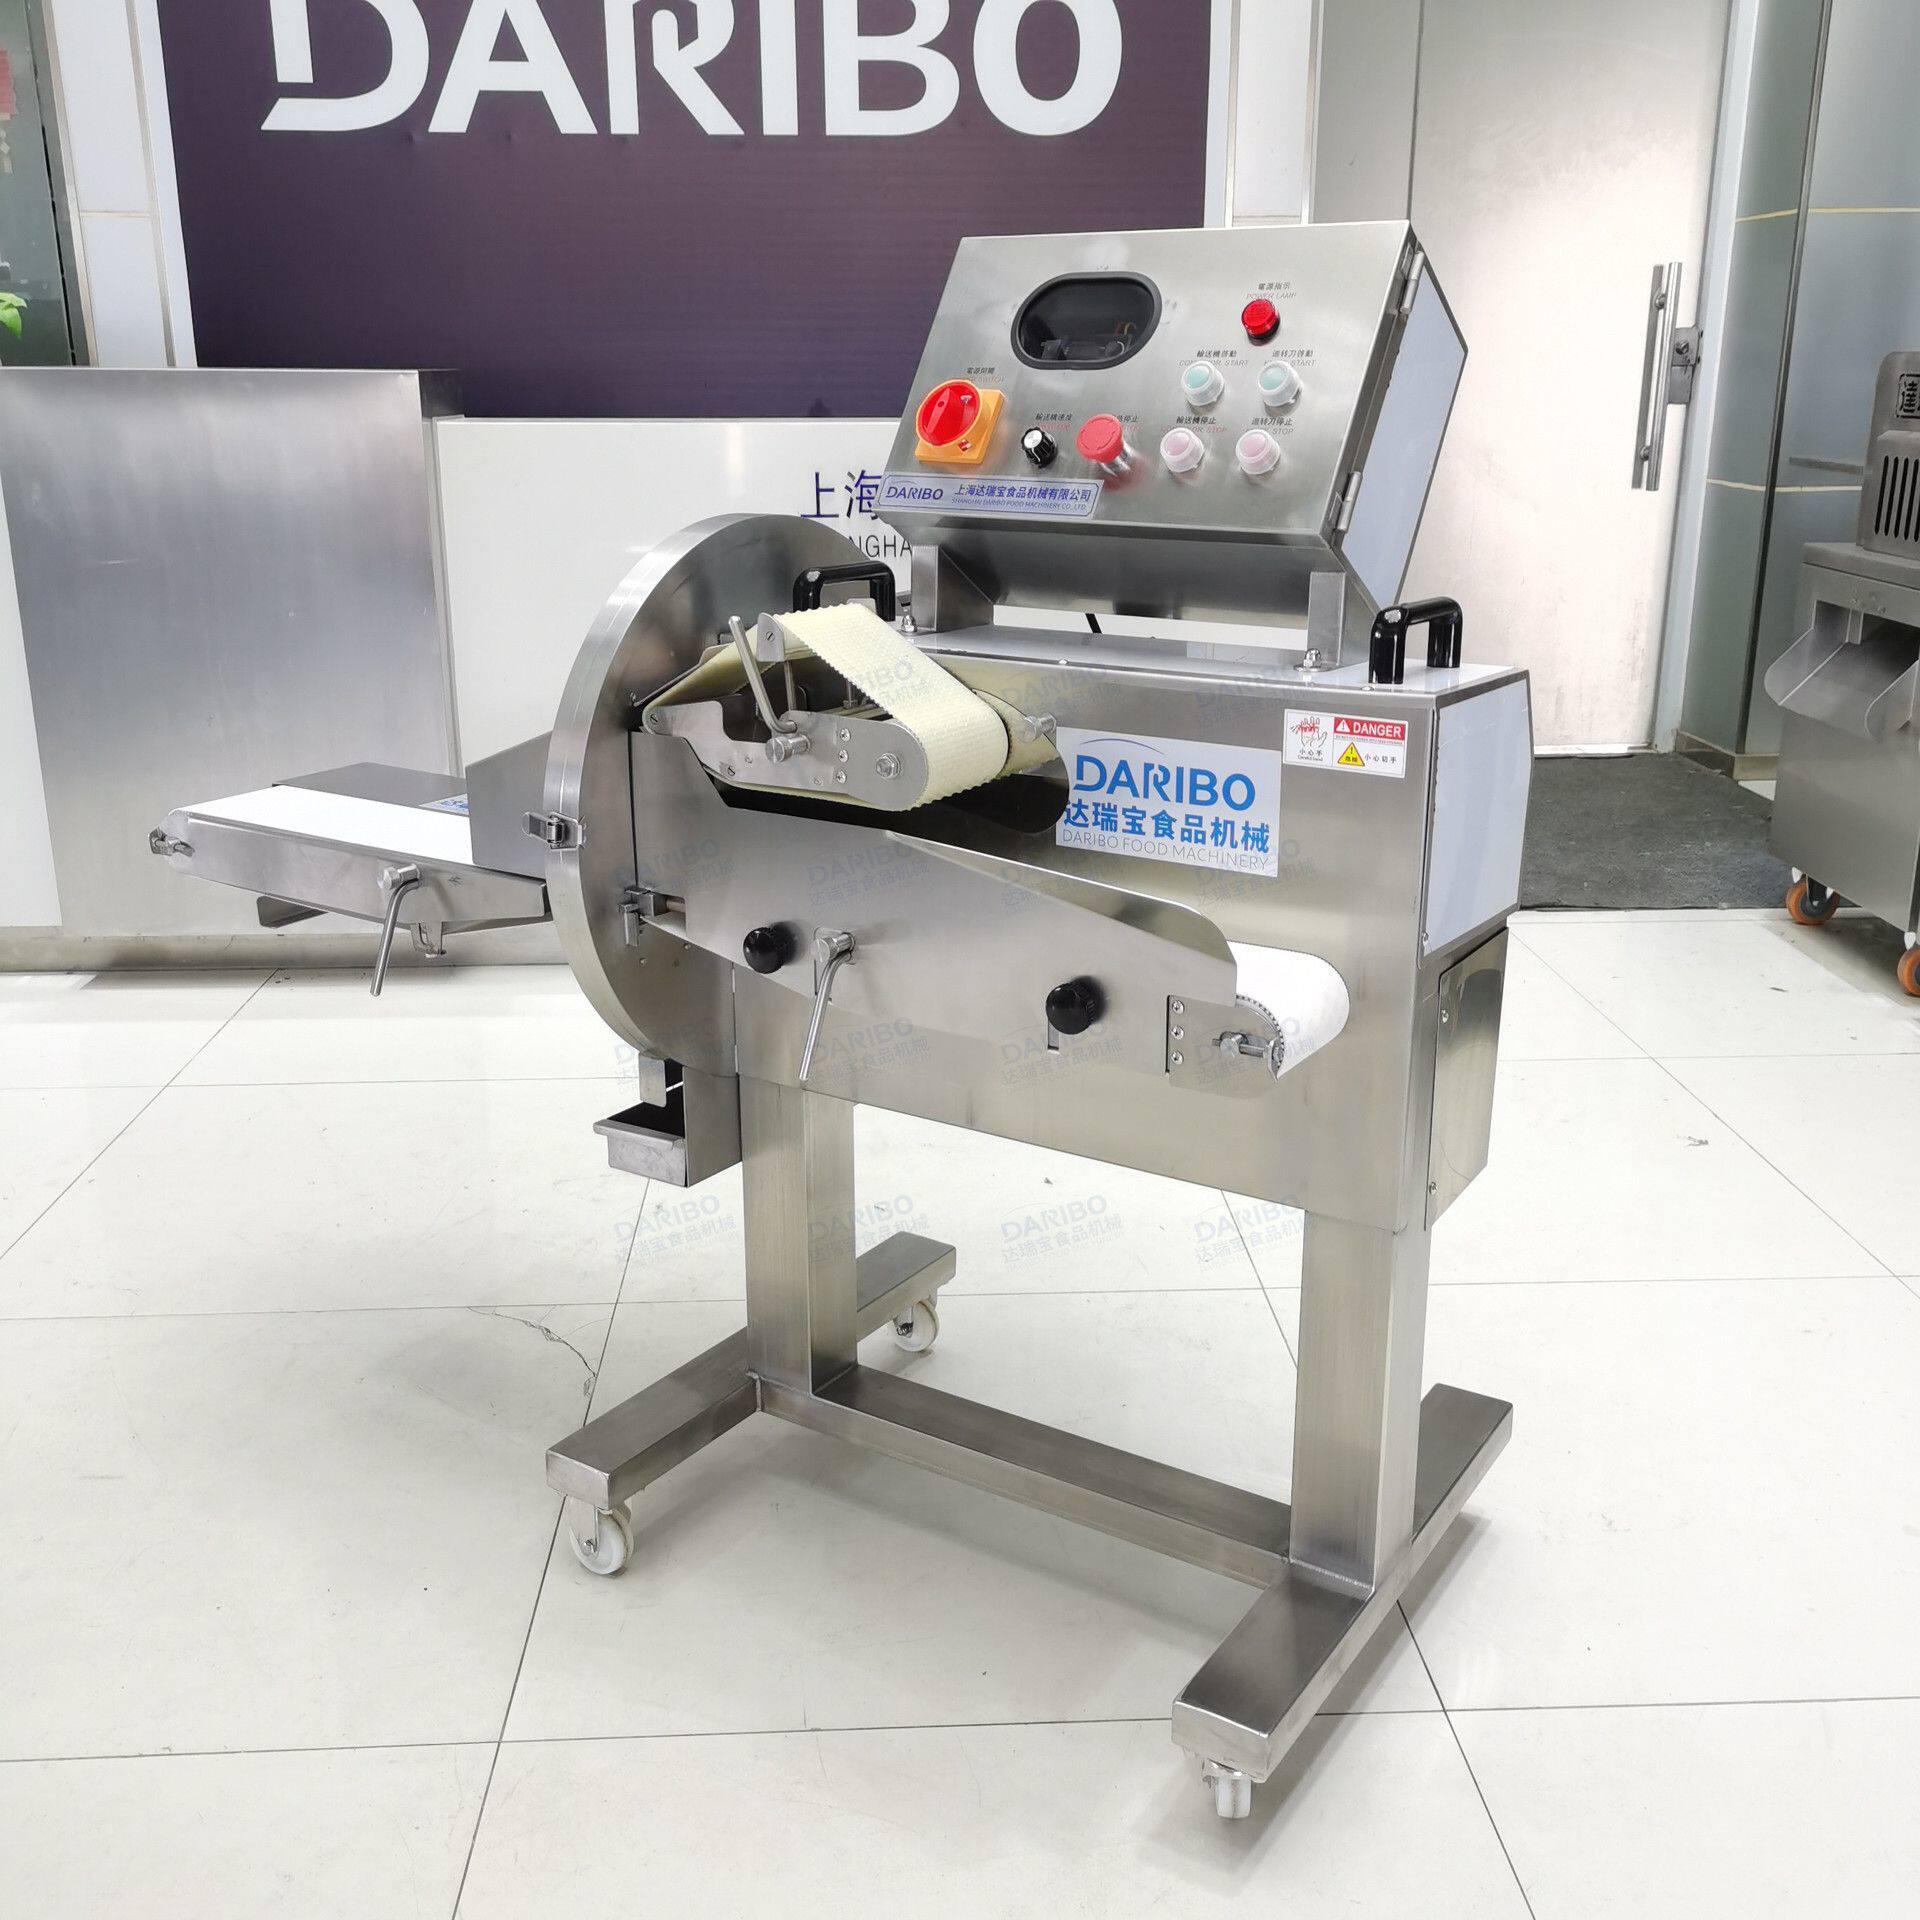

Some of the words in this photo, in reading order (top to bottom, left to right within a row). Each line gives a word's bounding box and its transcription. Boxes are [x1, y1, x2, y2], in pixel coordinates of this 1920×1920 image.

[262, 0, 1122, 136] DARIBO
[1272, 428, 1295, 436] STOP
[885, 486, 944, 500] DARIBO
[955, 483, 1091, 502] 上海达瑞宝食品机械有限公司
[1352, 720, 1403, 739] DANGER
[1072, 753, 1256, 812] DARIBO
[1063, 797, 1271, 854] 达瑞宝食品机械
[1062, 828, 1119, 849] DARIBO
[1122, 837, 1168, 857] FOOD
[1171, 844, 1270, 871] MACHINERY
